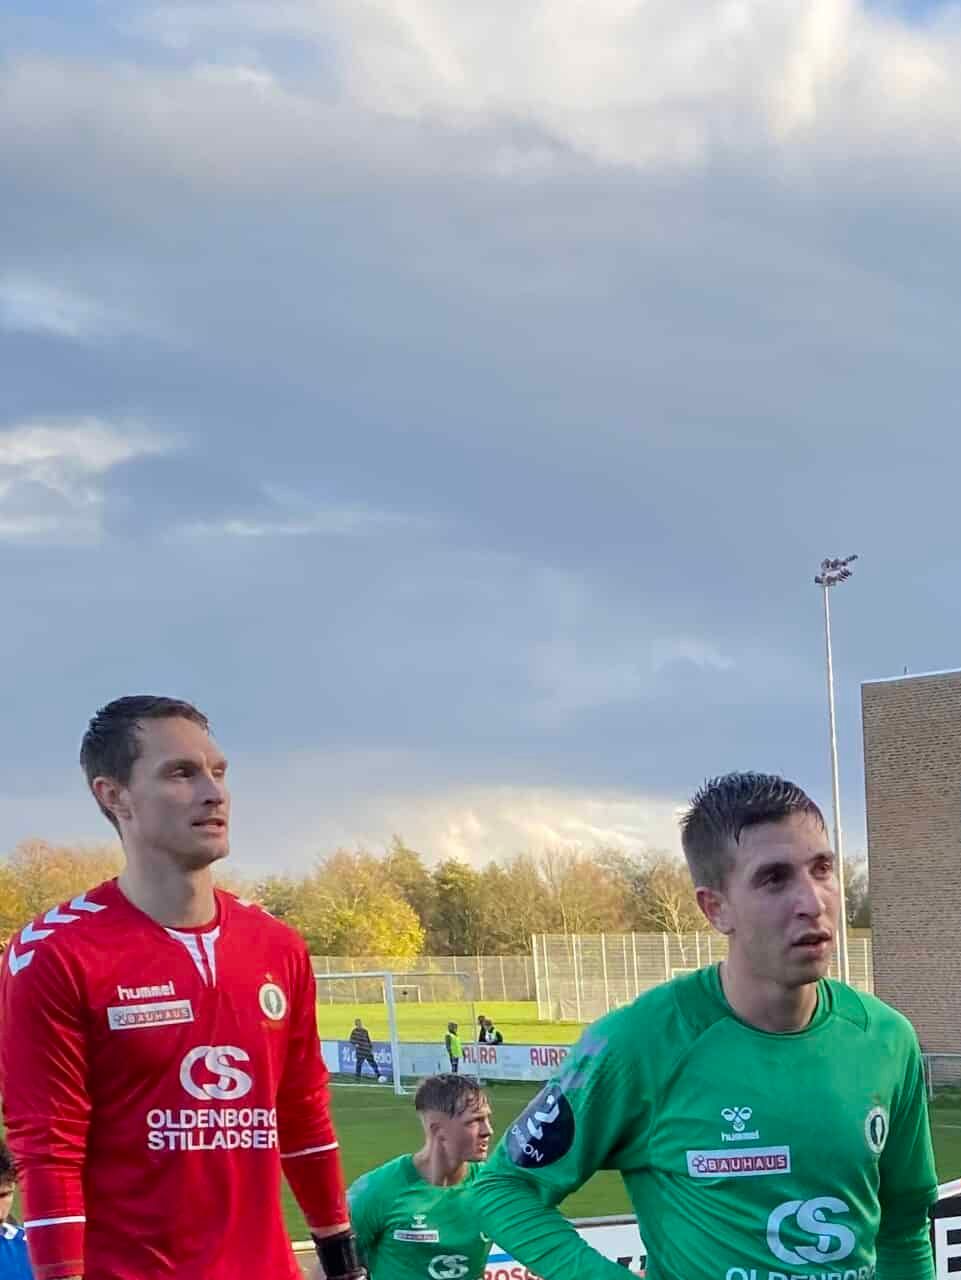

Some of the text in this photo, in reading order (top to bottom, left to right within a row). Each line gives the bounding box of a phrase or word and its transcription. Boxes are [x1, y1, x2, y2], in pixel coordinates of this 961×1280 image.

[117, 981, 176, 1000] hummel
[128, 1008, 190, 1024] BAUHAUS
[708, 1155, 786, 1171] BAUHAUS
